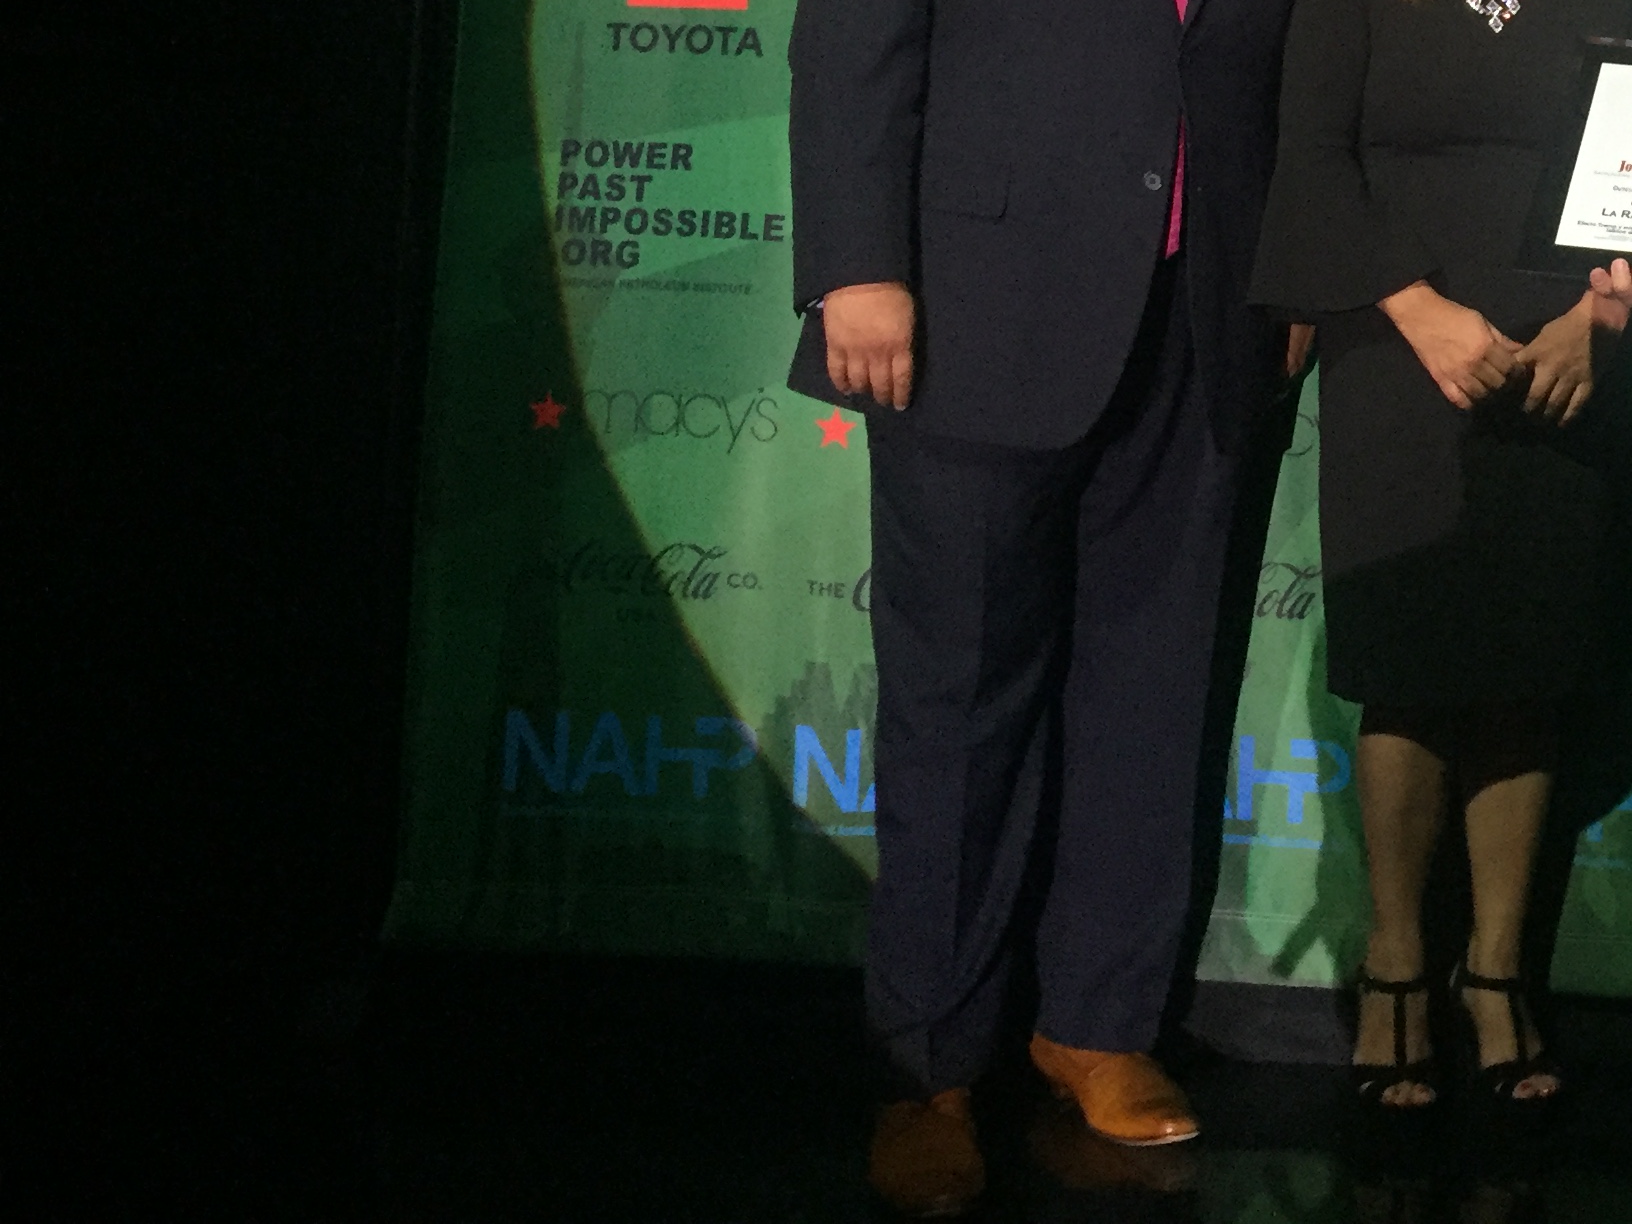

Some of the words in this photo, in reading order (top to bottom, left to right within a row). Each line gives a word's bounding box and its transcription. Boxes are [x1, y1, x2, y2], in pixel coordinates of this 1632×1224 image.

[606, 22, 763, 58] TOYOTA
[560, 139, 693, 171] POWER
[556, 173, 653, 203] PAST
[554, 205, 786, 243] IMPOSSIBLE
[560, 239, 640, 270] ORG
[585, 387, 778, 454] macy's
[806, 579, 845, 598] THE
[501, 707, 758, 799] NAHP
